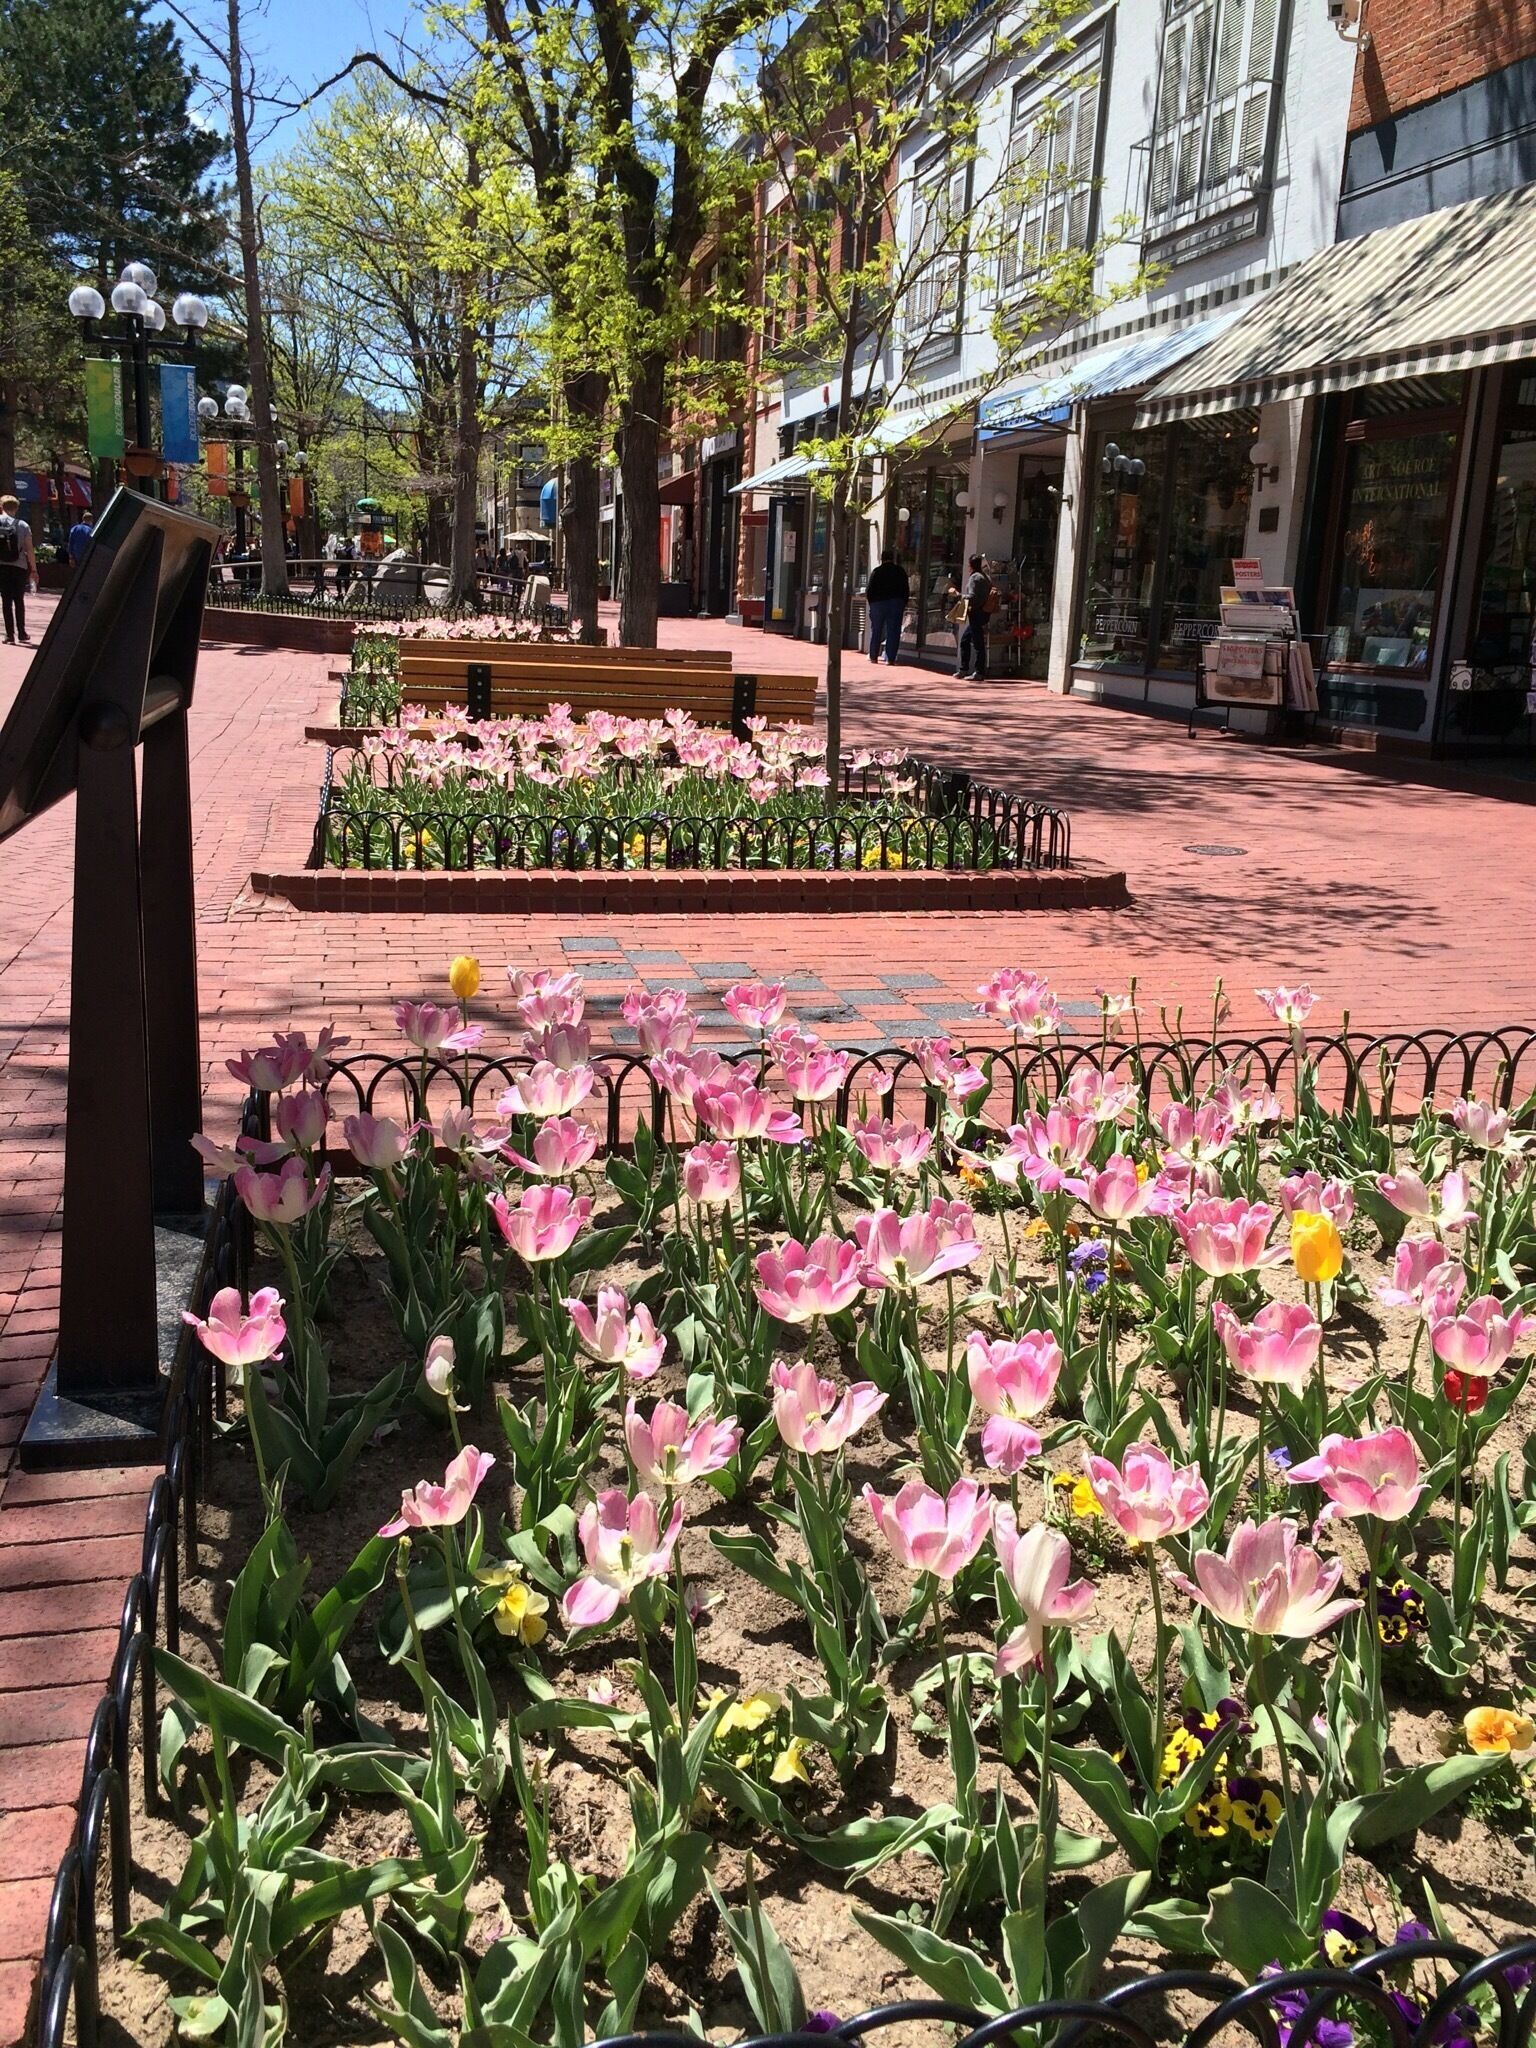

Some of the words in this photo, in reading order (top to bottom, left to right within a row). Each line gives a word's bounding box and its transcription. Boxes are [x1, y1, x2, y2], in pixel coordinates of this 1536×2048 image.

[1391, 458, 1436, 477] SOURCE
[1351, 480, 1441, 504] INTERNATIONAL
[1095, 618, 1138, 633] PEPPERCORN
